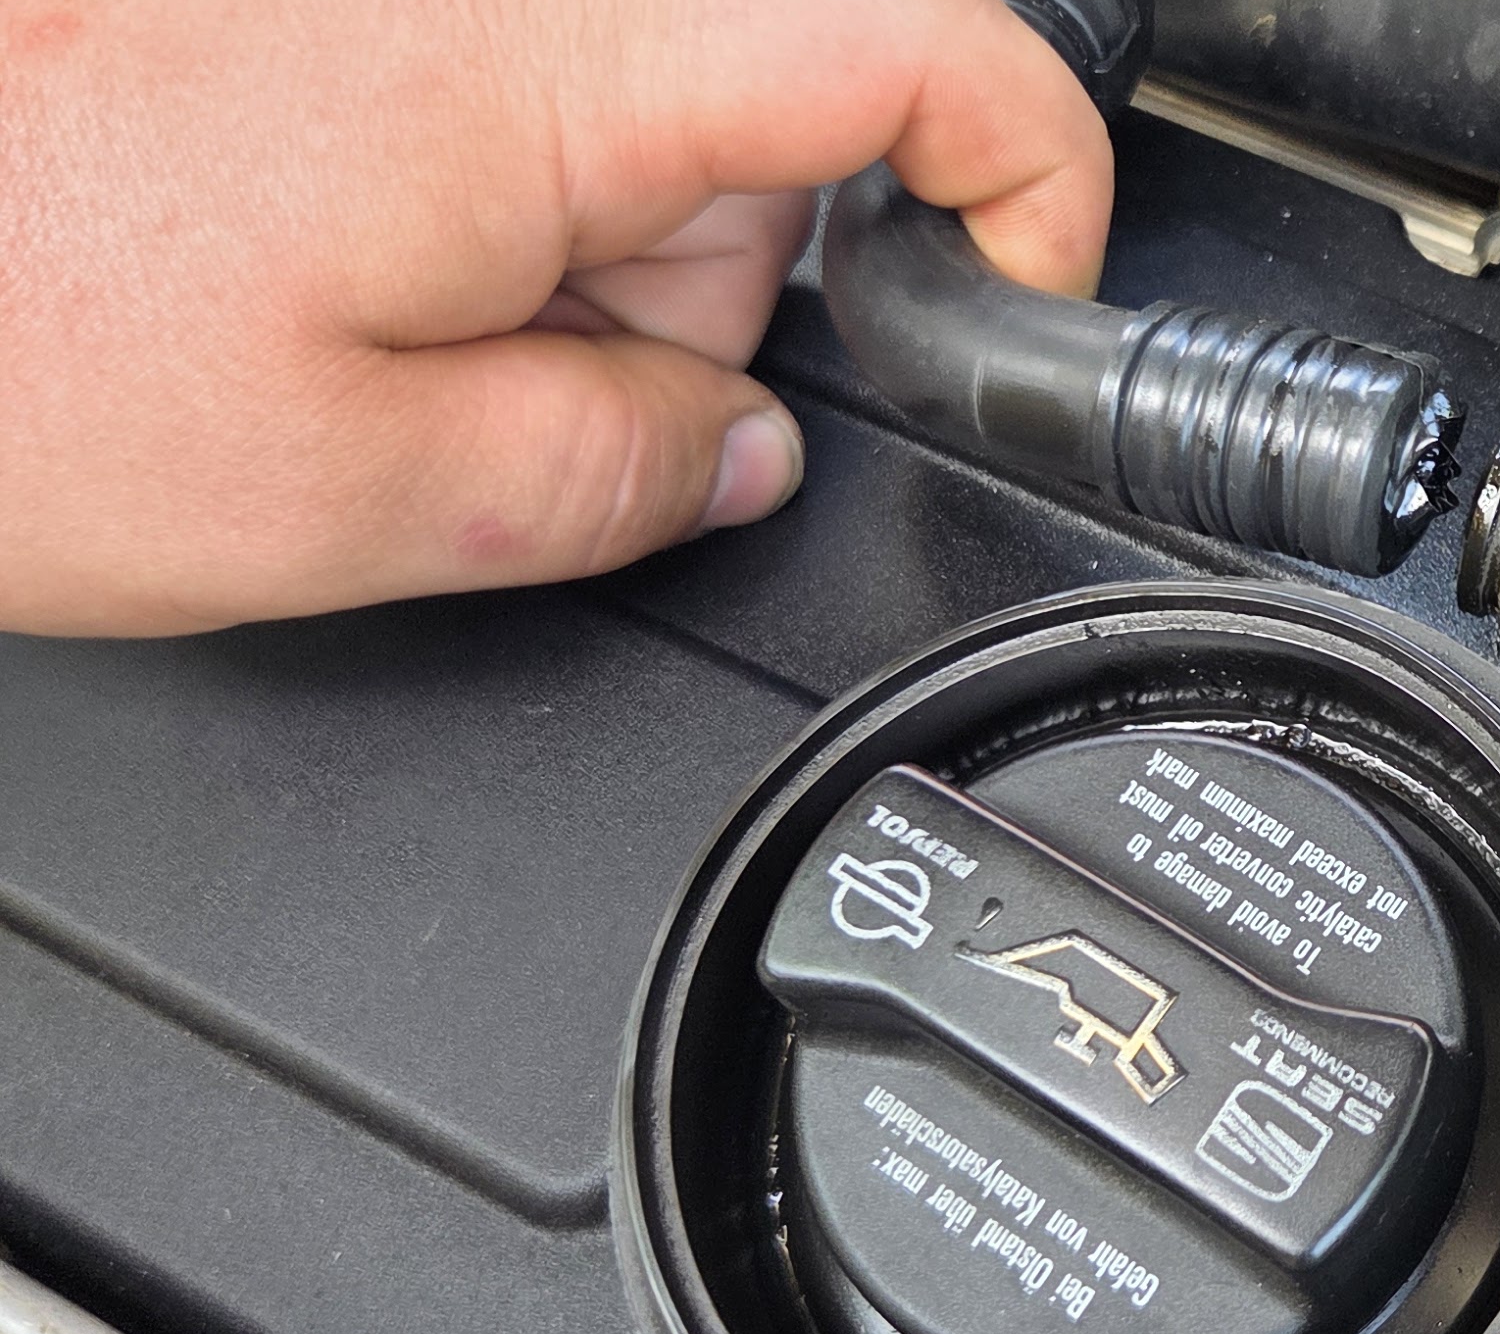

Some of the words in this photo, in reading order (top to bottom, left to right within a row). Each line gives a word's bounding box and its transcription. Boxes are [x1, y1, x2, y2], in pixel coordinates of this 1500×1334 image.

[1145, 747, 1200, 790] mark
[1119, 779, 1175, 824] must
[1167, 813, 1205, 843] oil
[1200, 780, 1295, 849] maximum
[866, 804, 980, 880] REPSOL
[1126, 833, 1153, 863] to
[1200, 831, 1295, 899] converter
[1288, 839, 1368, 895] exceed
[1153, 849, 1233, 913] damage
[1366, 885, 1409, 920] not
[1227, 899, 1292, 946] avoid
[1295, 890, 1383, 954] catalytic
[1292, 937, 1322, 976] To
[1229, 1034, 1383, 1136] SEAT
[1250, 1008, 1396, 1109] RECOMMENDS
[863, 1085, 1046, 1227] Katalysatorschäden
[870, 1145, 930, 1196] max:
[924, 1183, 978, 1235] über
[1044, 1208, 1088, 1252] von
[970, 1217, 1054, 1296] Ölstand
[1087, 1240, 1160, 1307] Gefahr
[1048, 1272, 1096, 1321] Bei
